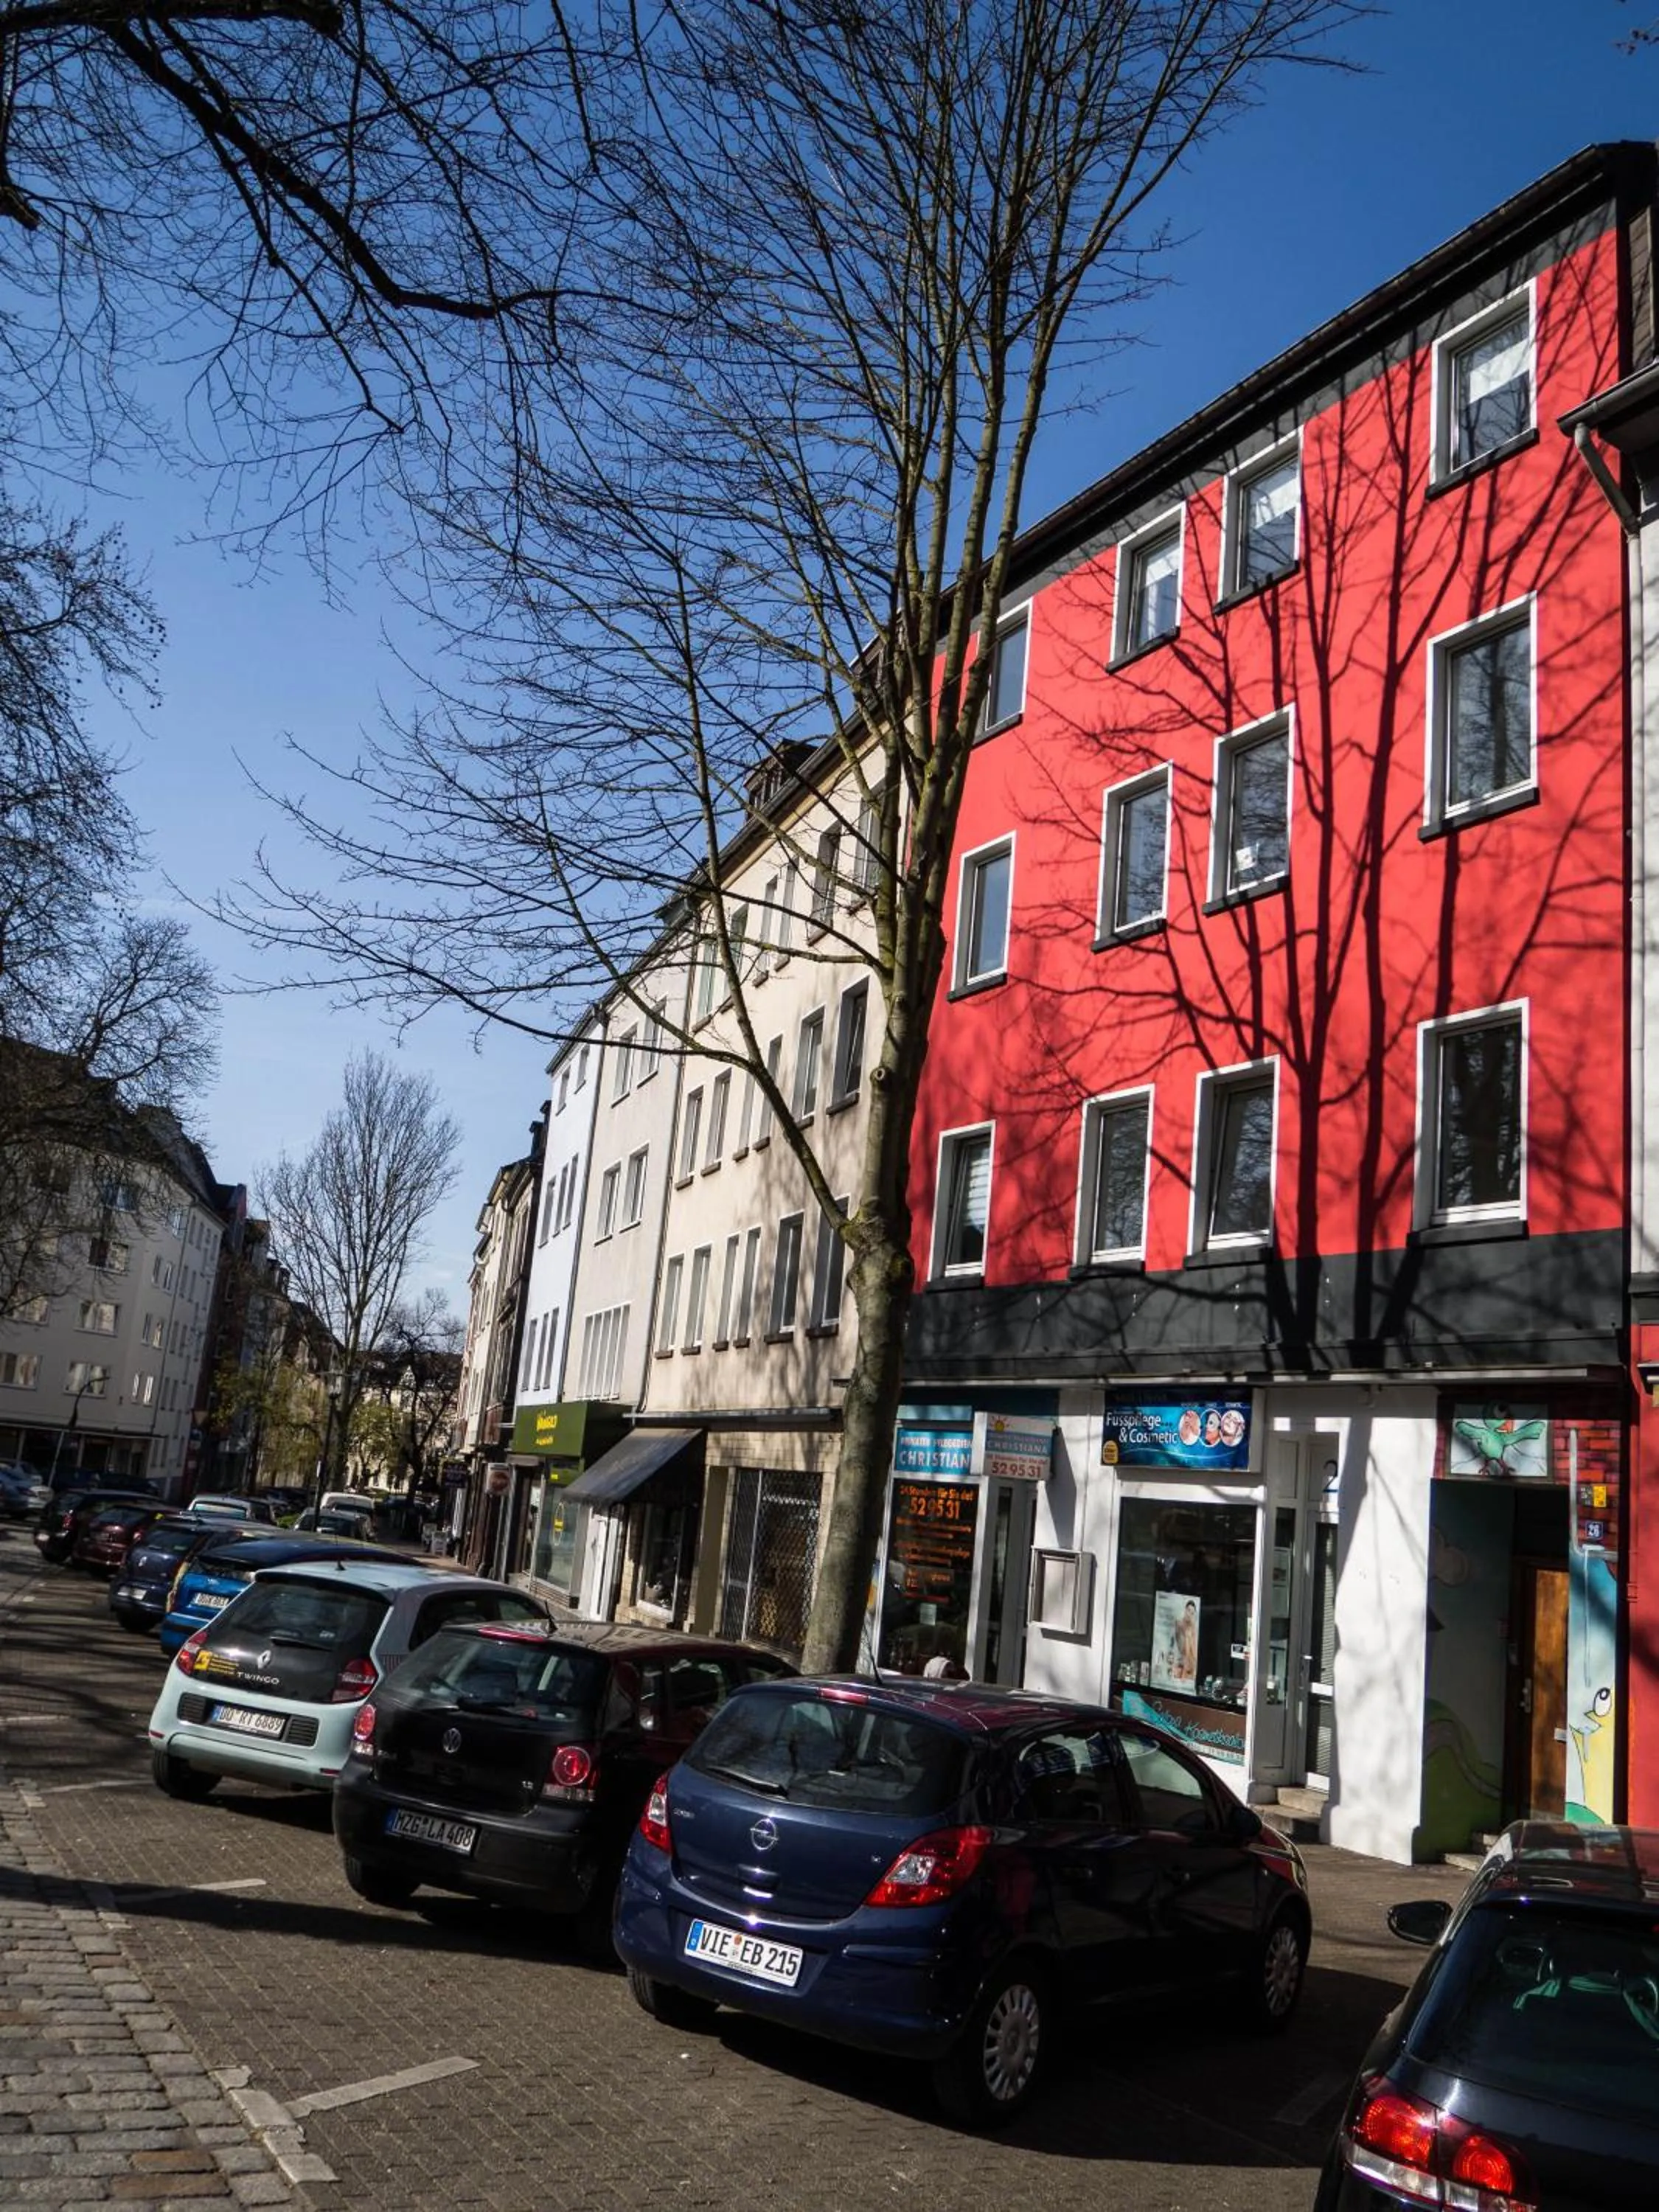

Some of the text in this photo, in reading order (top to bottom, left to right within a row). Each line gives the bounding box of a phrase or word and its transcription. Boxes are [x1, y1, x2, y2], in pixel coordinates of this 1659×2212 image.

[1119, 1427, 1179, 1444] & Cosmetic
[987, 1440, 1048, 1454] CHRISTIANA
[899, 1450, 970, 1468] CHRISTIAN
[991, 1461, 1041, 1478] 52 95 31
[908, 1497, 926, 1516] 52
[946, 1500, 961, 1520] 31
[237, 1672, 279, 1685] TWINGO
[427, 1818, 445, 1840] LA
[447, 1825, 473, 1847] 408
[700, 1926, 731, 1958] VIE
[740, 1940, 765, 1966] EB
[765, 1947, 799, 1977] 215
